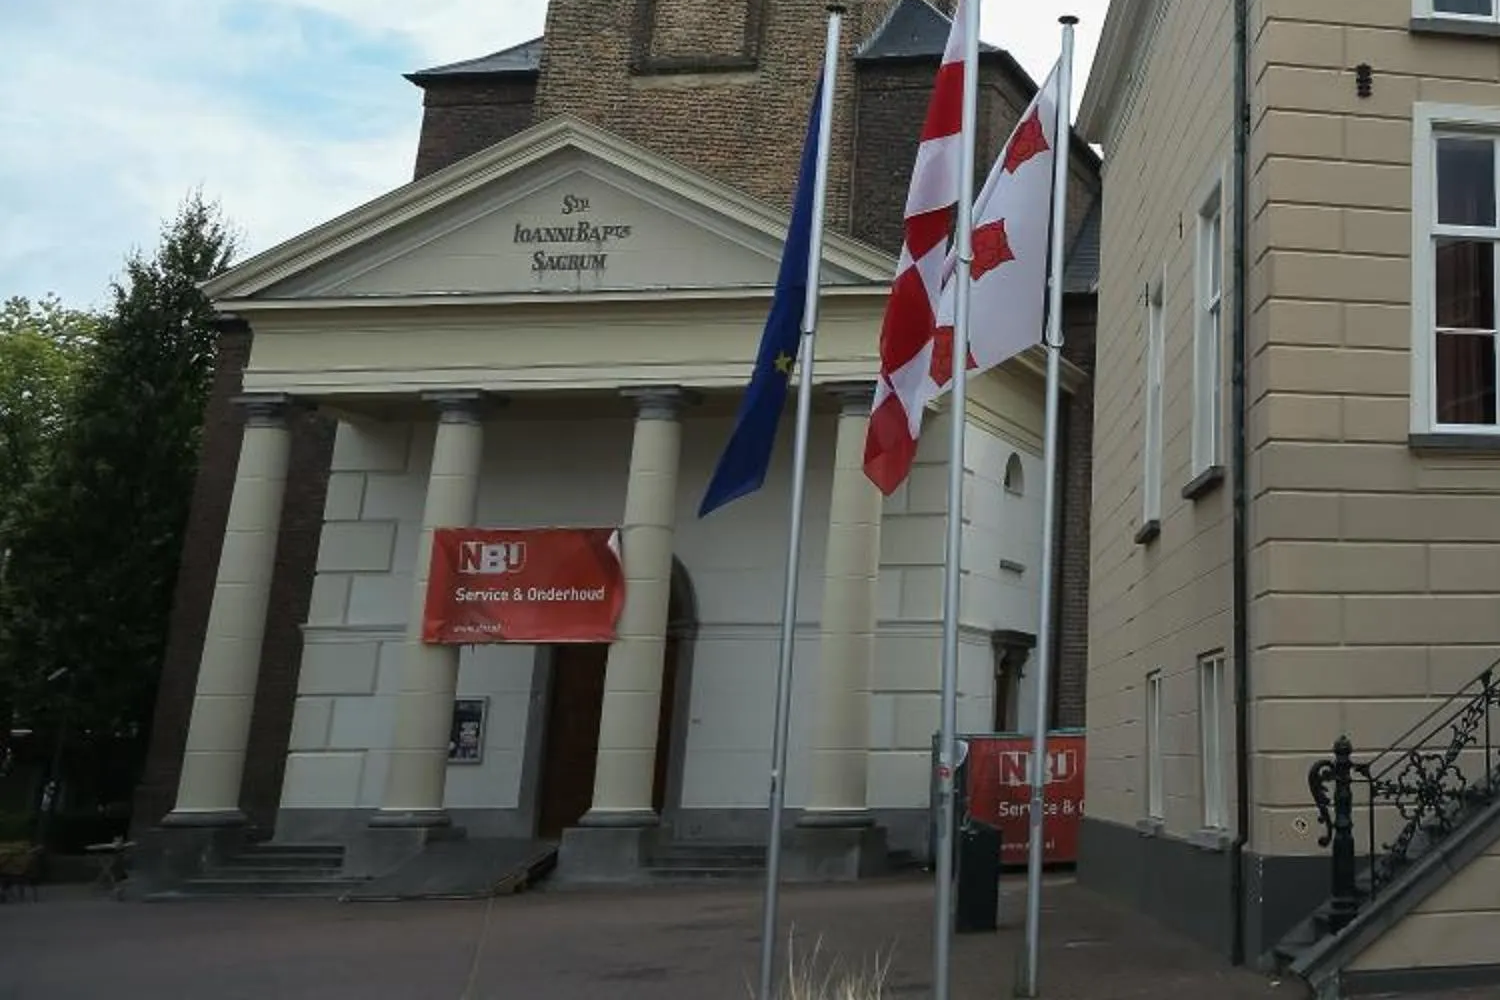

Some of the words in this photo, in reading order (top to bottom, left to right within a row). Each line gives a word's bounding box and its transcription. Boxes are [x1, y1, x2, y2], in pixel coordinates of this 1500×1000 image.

[458, 541, 527, 574] NBU
[455, 586, 509, 602] Service
[514, 587, 523, 601] &
[527, 586, 605, 601] Onderhoud
[1063, 800, 1076, 815] &
